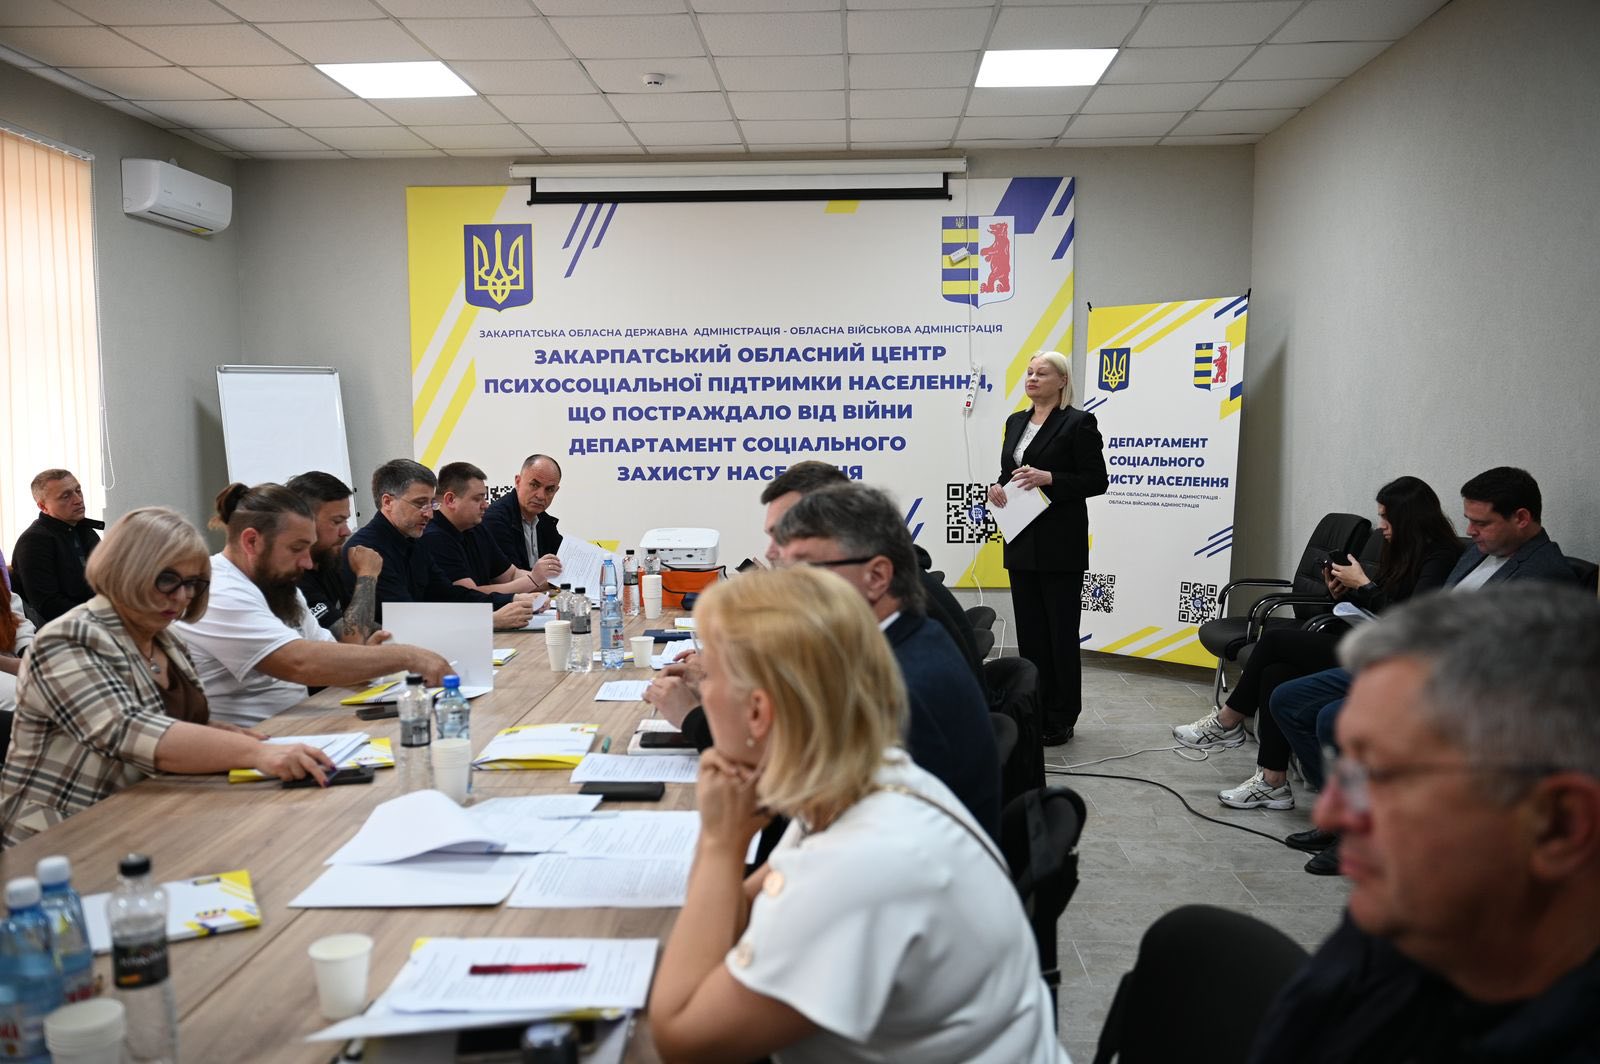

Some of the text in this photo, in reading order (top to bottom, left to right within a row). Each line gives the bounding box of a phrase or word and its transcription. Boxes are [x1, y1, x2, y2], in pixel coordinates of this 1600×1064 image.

[479, 329, 566, 338] ЗАКАРПАТСЬКА
[568, 328, 622, 337] ОБЛАСНА
[624, 328, 688, 338] ДЕРЖАВНА
[693, 326, 781, 337] АДМІНІСТРАЦІЯ
[790, 326, 844, 335] ОБЛАСНА
[847, 324, 912, 335] ВІЙСЬКОВА
[914, 324, 1003, 335] АДМІНІСТРАЦІЯ
[534, 343, 947, 365] ЗАКАРПАТСЬКИЙ ОБЛАСНИЙ ЦЕНТР
[484, 373, 702, 395] ПСИХОСОЦІАЛЬНОЇ
[708, 376, 842, 394] ПІДТРИМКИ
[568, 400, 913, 424] ЩО ПОСТРАЖДАЛО ВІД ВІЙНИ
[568, 436, 907, 455] ДЕПАРТАМЕНТ СОЦІАЛЬНОГО
[1108, 437, 1208, 449] ДЕПАРТАМЕНТ
[1109, 456, 1205, 468] СОЦІАЛЬНОГО
[617, 465, 863, 481] ЗАХИСТУ НАСЕНЯ
[1107, 474, 1229, 488] ИСТУ НАСЕЛЕННЯ
